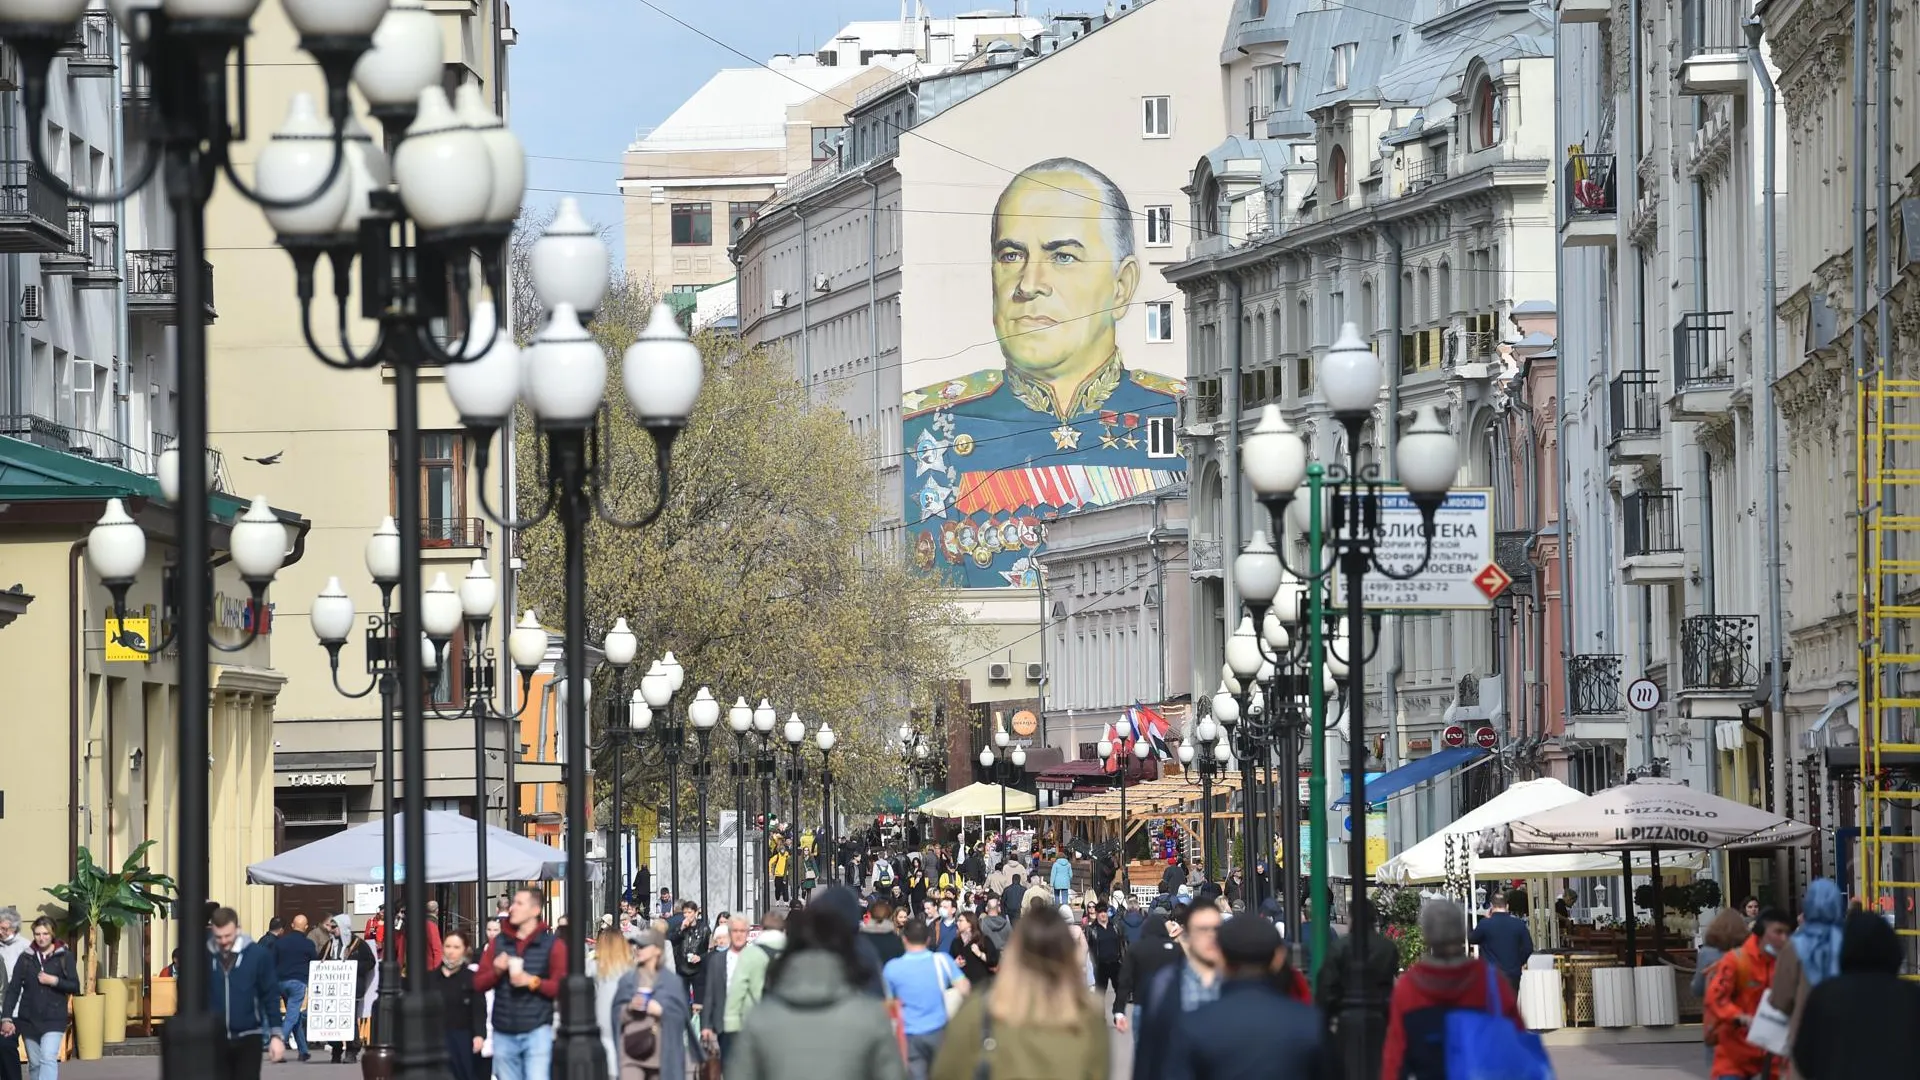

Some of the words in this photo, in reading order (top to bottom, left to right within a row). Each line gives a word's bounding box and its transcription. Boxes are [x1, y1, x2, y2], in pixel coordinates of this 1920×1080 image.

[1362, 523, 1477, 538] БЛИОТЕКА
[1414, 541, 1460, 549] РУСКОЙ
[1429, 552, 1479, 561] УЛЬТУРЫ
[1343, 594, 1375, 602] ААТ
[288, 773, 347, 786] ТАБАК
[1624, 806, 1719, 819] PIZZAIOLO
[1615, 827, 1628, 841] IL
[1631, 826, 1709, 844] PIZZAIOLO
[313, 973, 351, 981] РЕМОНТ
